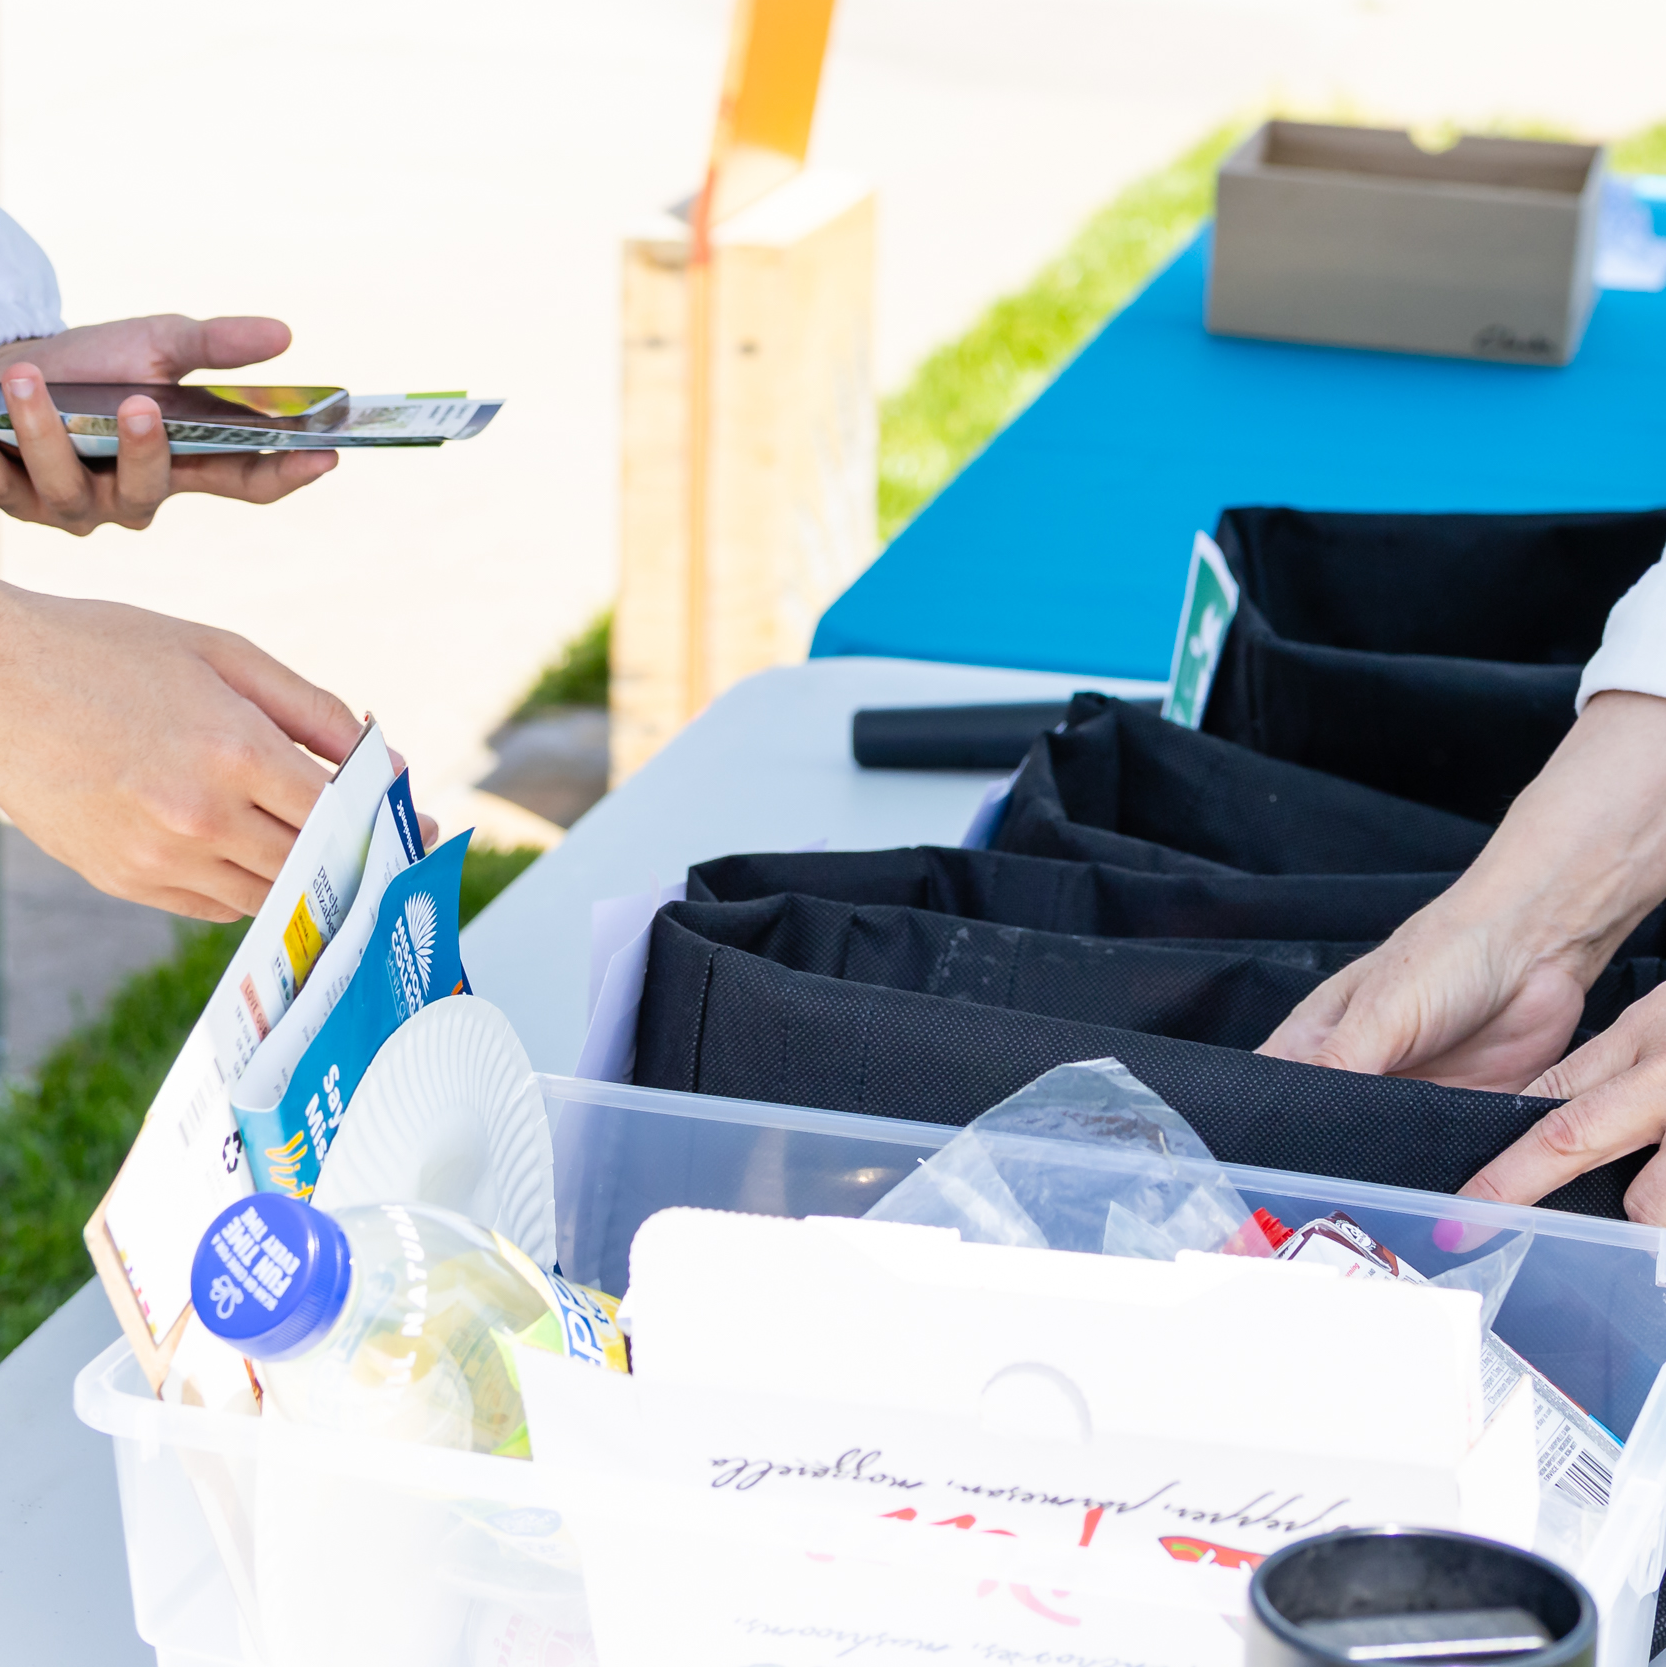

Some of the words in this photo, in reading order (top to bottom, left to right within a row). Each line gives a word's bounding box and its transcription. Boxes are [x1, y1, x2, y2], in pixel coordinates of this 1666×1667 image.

[317, 865, 339, 915] purely
[387, 950, 401, 998] SANTA
[391, 931, 416, 1017] COLLEG
[395, 916, 424, 1011] MISSION
[244, 984, 259, 1017] LOVE
[323, 1064, 345, 1129] Say
[305, 1092, 327, 1168] Mis
[221, 1216, 260, 1267] TIME
[240, 1205, 268, 1242] TIME
[251, 1255, 292, 1298] FUN
[260, 1234, 301, 1276] EVERY
[708, 1448, 927, 1491] mozzarella
